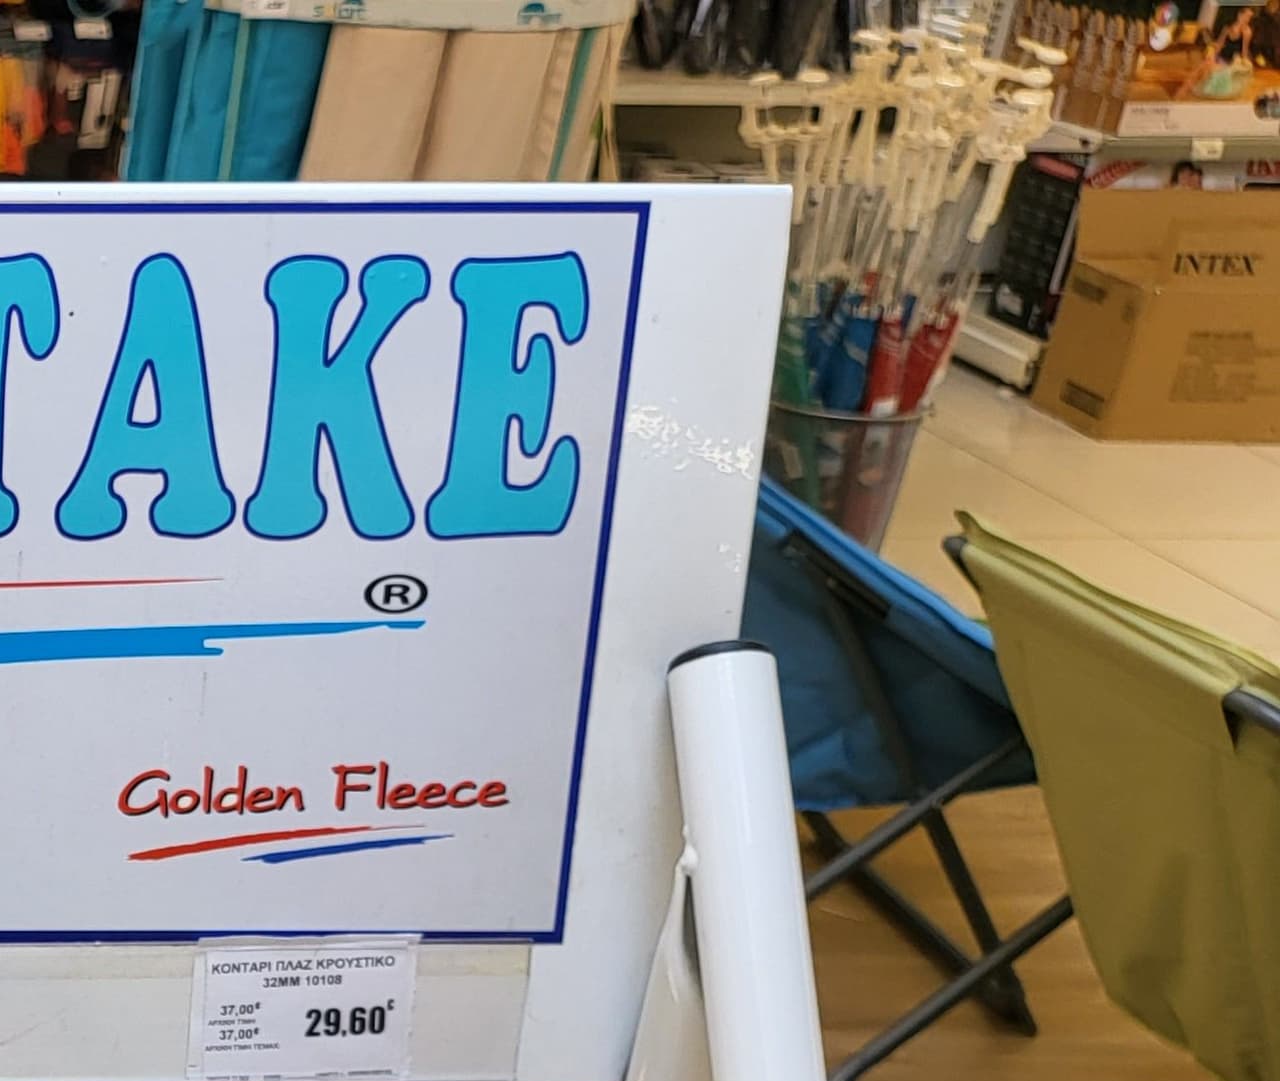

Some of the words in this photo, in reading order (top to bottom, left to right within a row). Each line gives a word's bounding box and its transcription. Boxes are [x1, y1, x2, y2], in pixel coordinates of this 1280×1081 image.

[1174, 253, 1255, 275] INTEX
[118, 765, 304, 818] Golden
[332, 761, 510, 810] Fleece
[211, 962, 271, 975] ΚΟΝΤΑΡΙ
[276, 960, 312, 971] ΠΛΑΖ
[316, 956, 395, 970] ΚΡΟΥΣΤΙΚΟ
